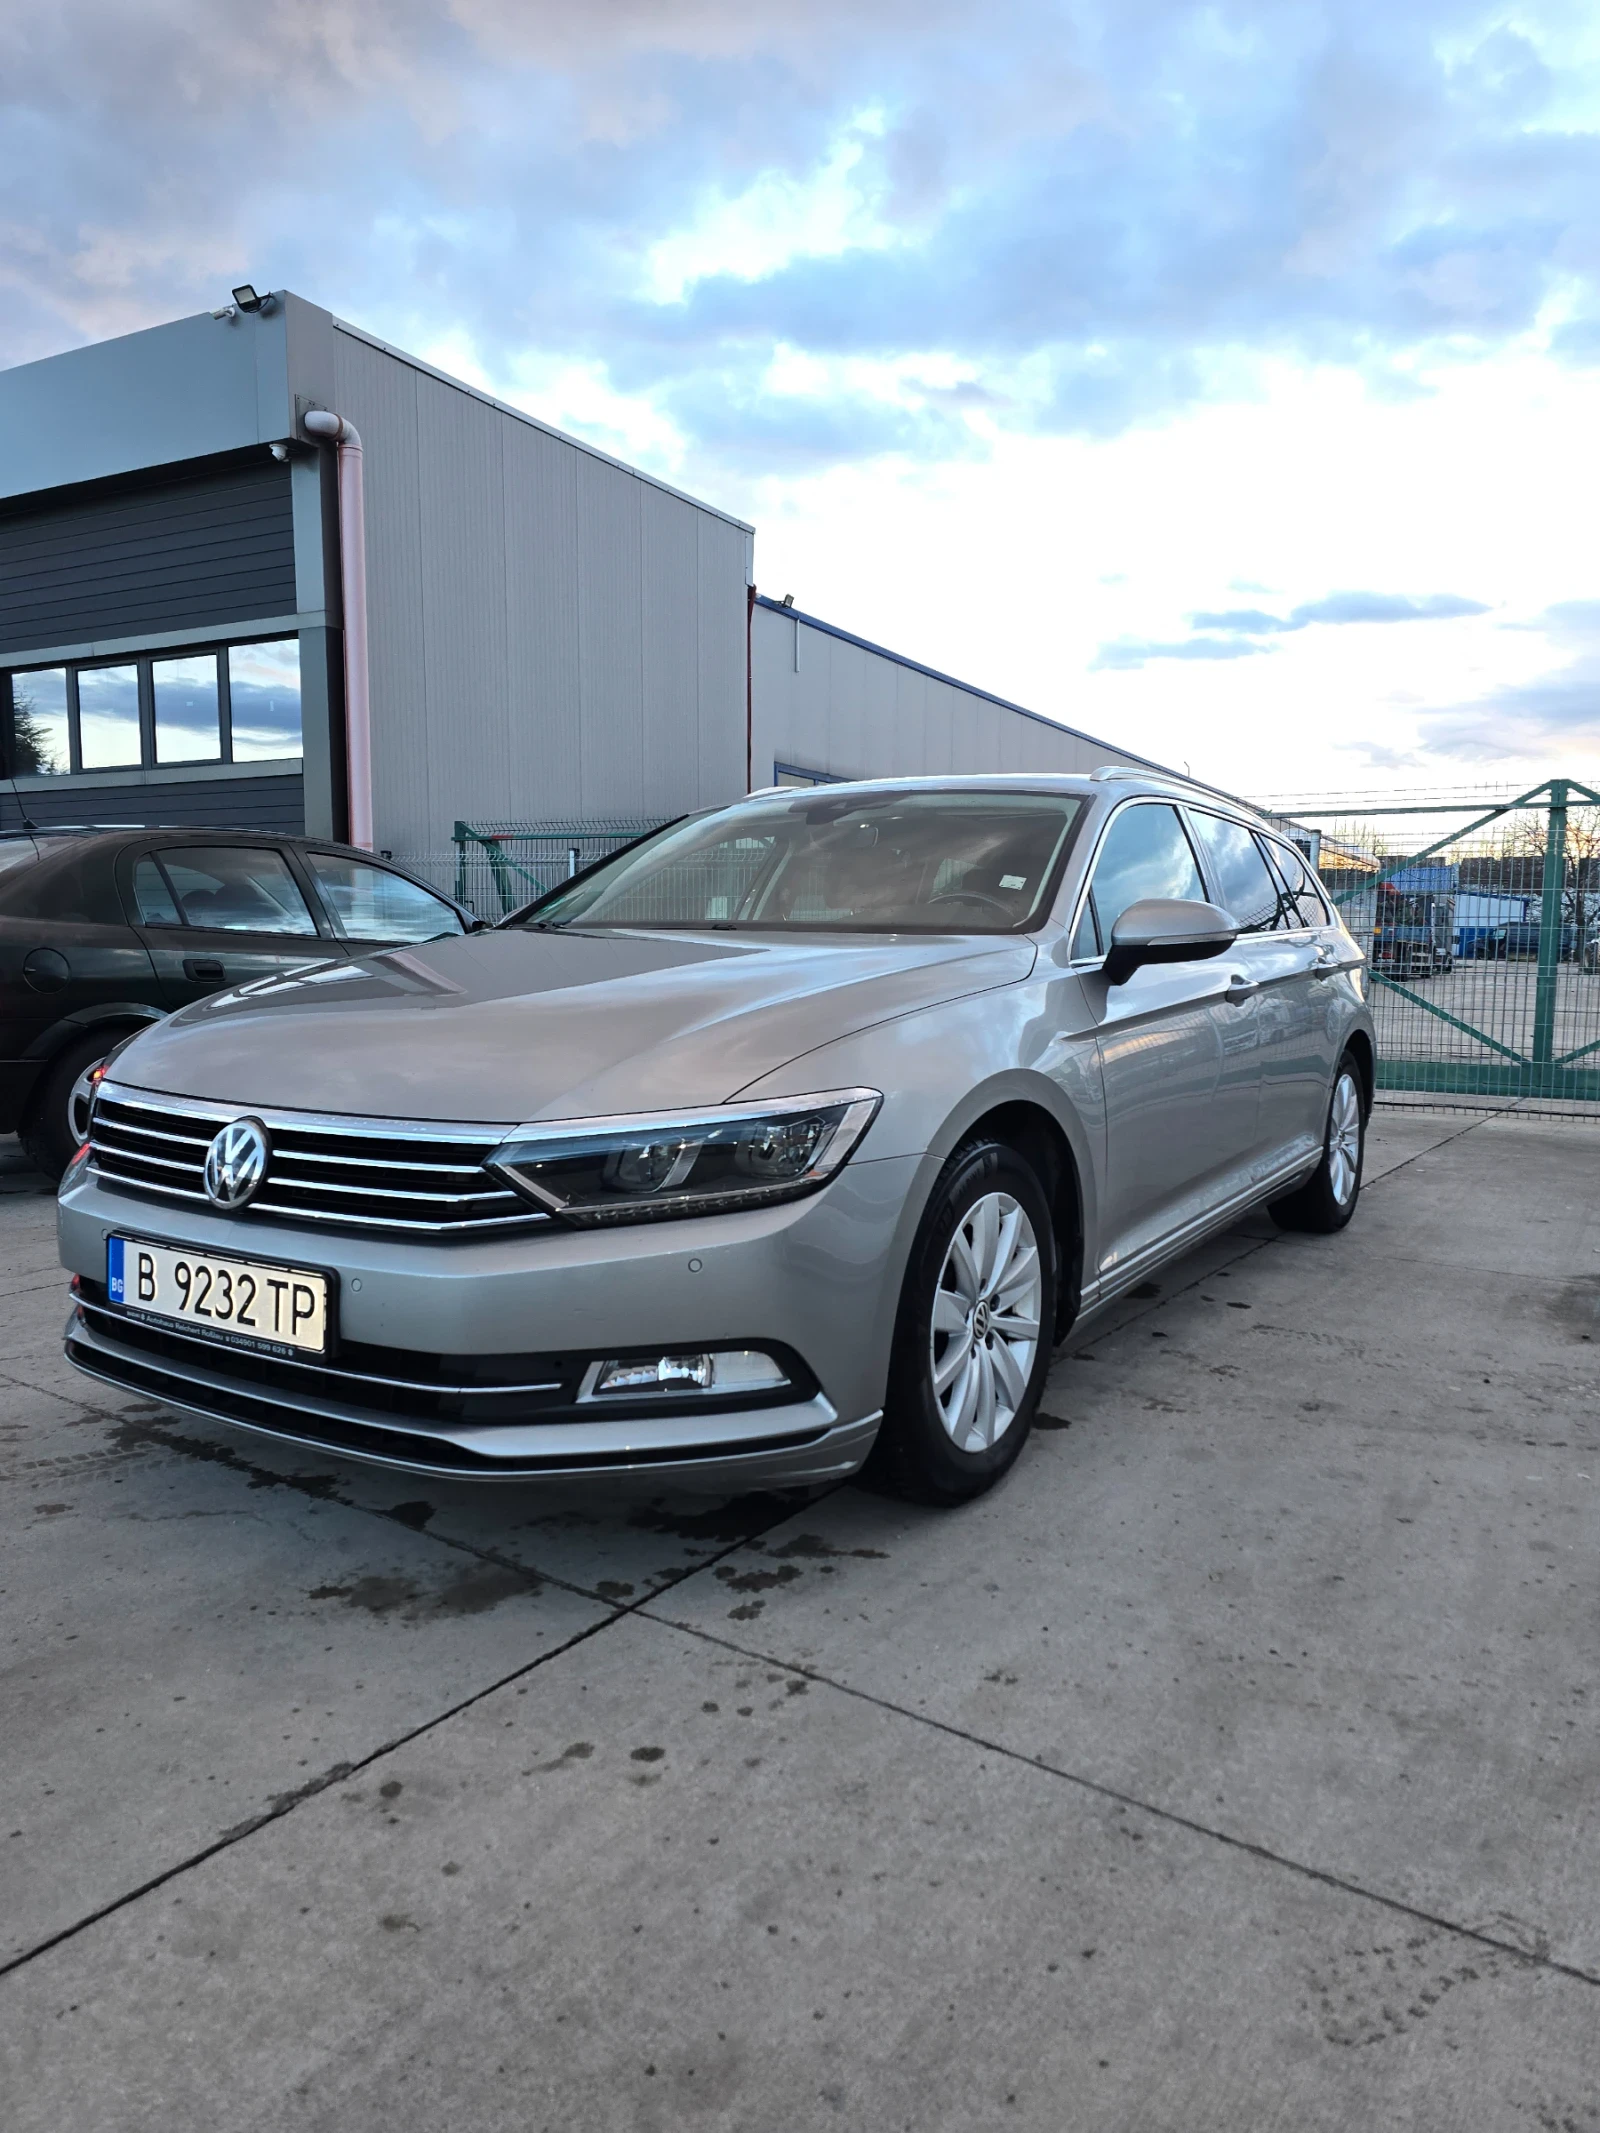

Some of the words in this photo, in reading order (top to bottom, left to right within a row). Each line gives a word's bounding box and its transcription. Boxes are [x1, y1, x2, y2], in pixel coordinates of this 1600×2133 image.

[111, 1277, 123, 1293] BG
[138, 1252, 155, 1301] B
[174, 1261, 256, 1327] 9232
[267, 1278, 315, 1335] TP
[146, 1315, 174, 1328] Autohaus
[175, 1322, 200, 1334] Reichert
[230, 1336, 255, 1348] 034901
